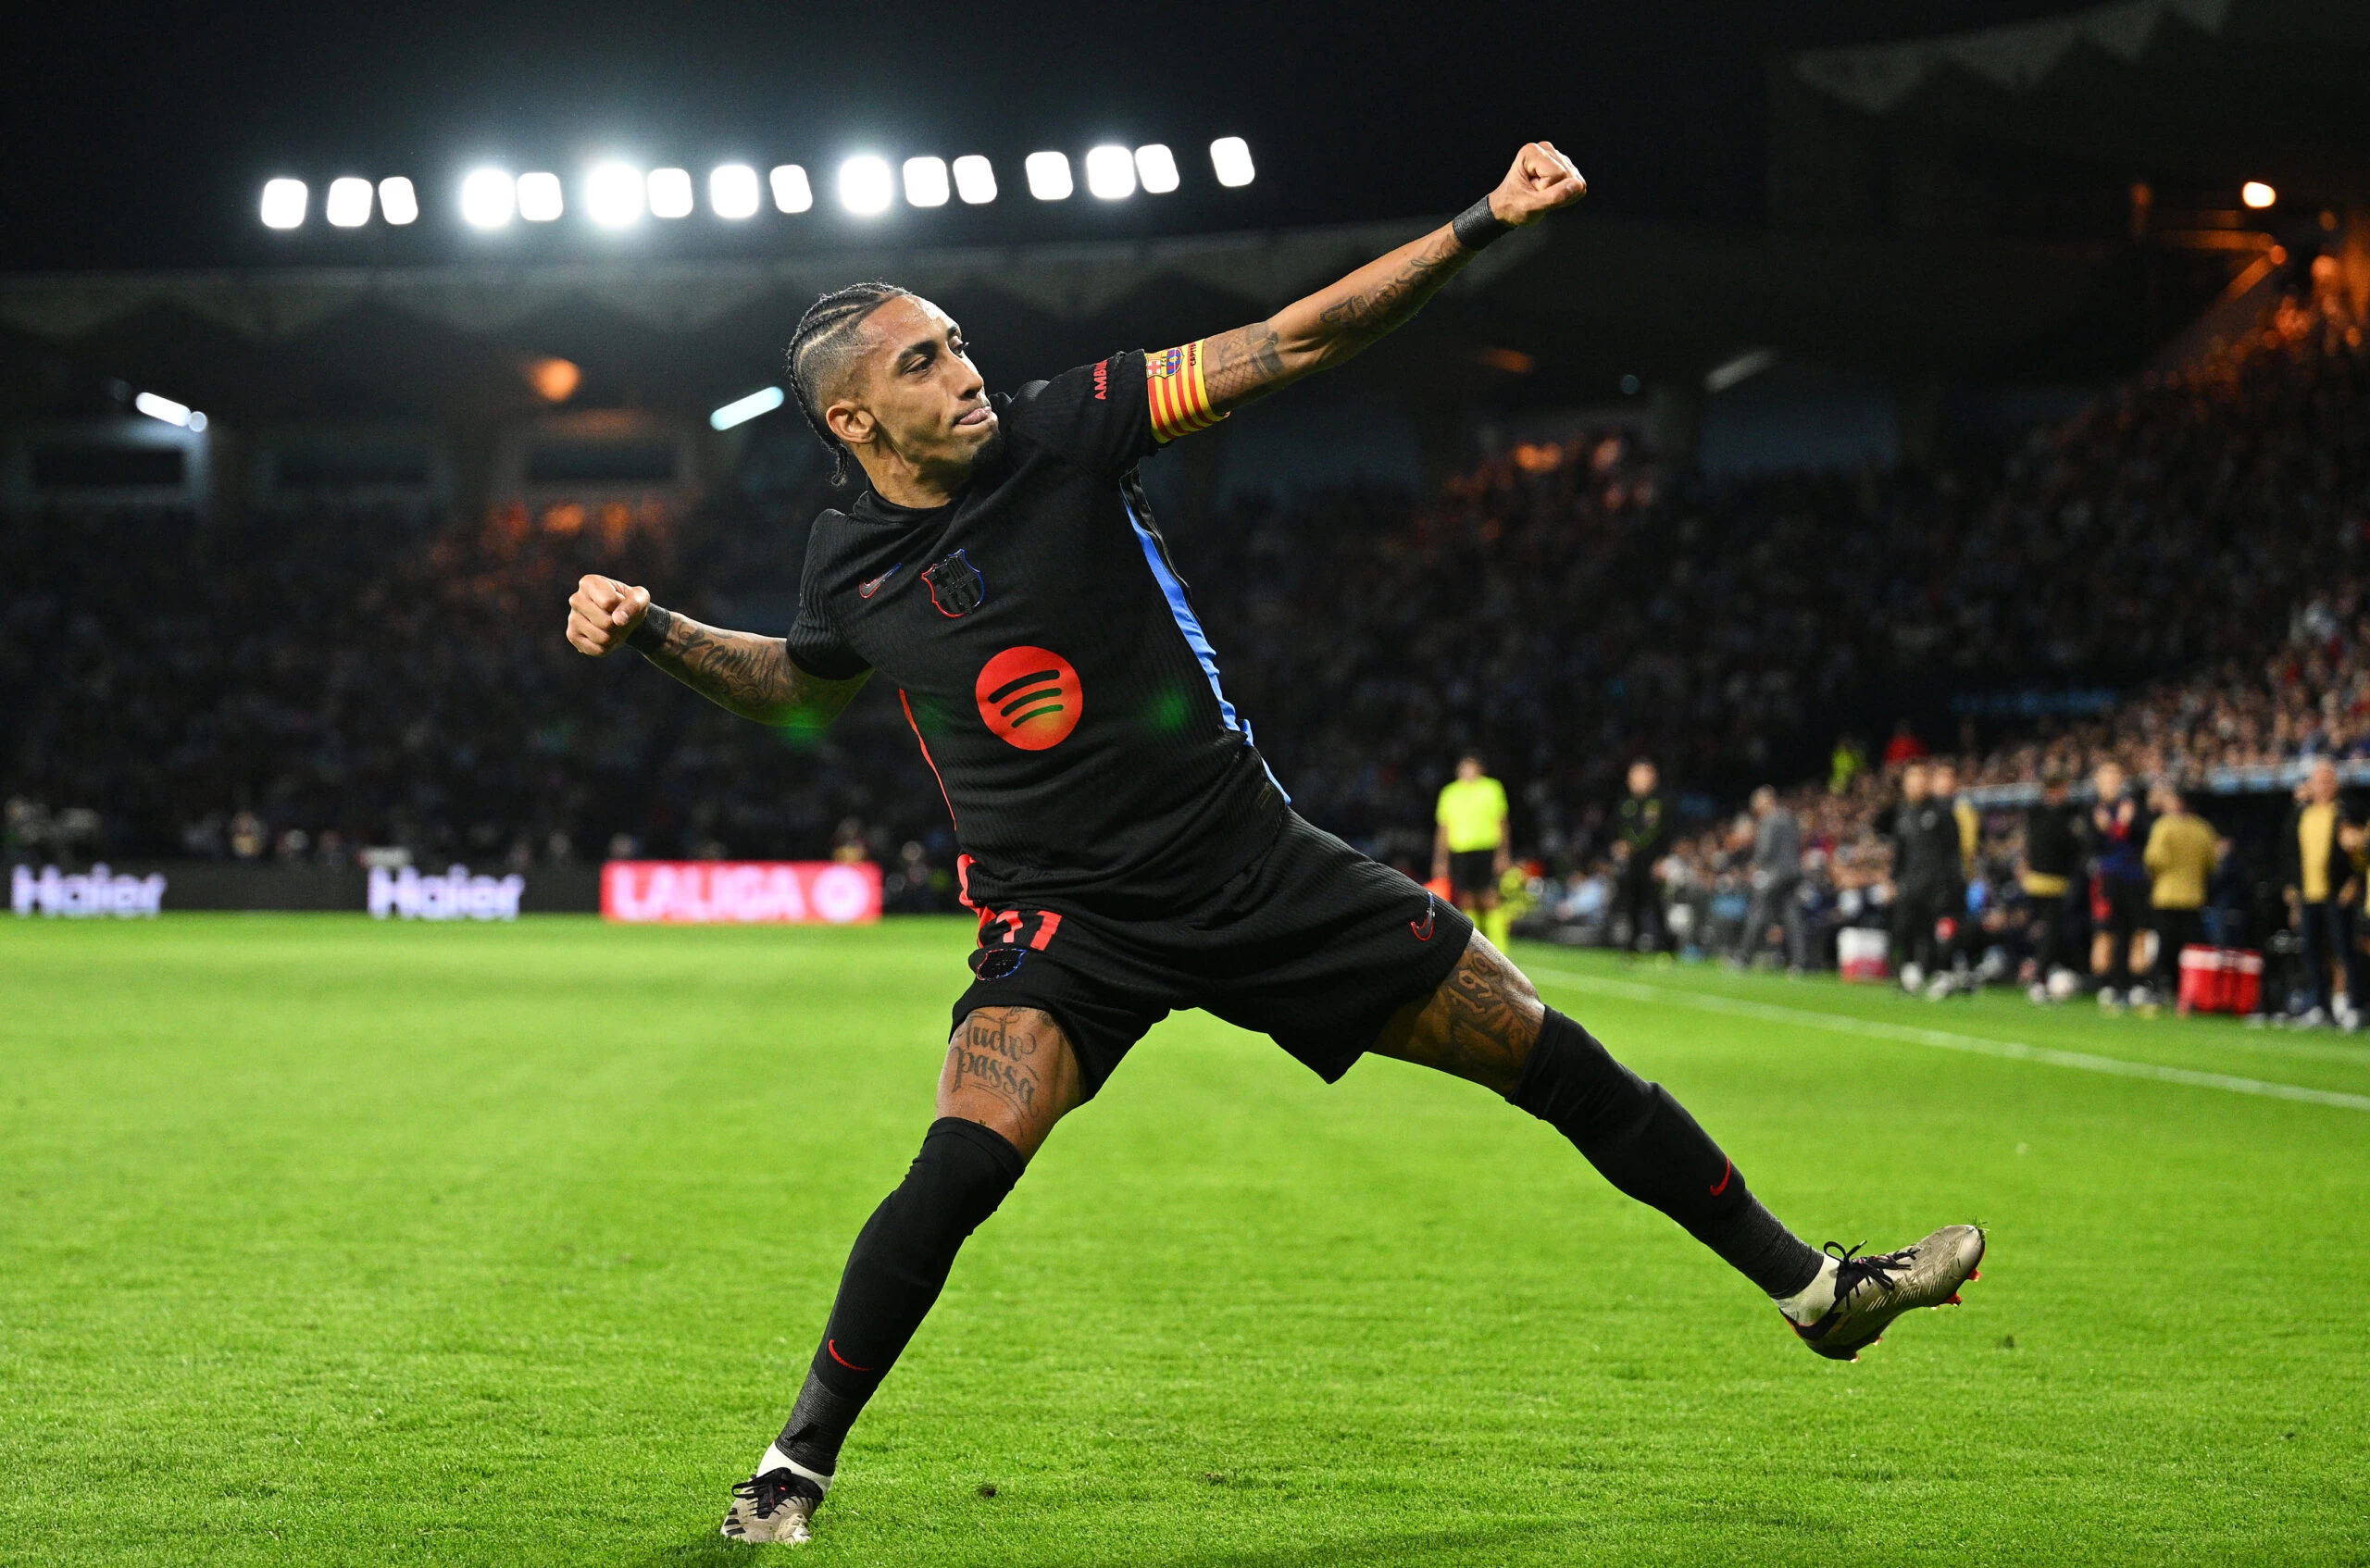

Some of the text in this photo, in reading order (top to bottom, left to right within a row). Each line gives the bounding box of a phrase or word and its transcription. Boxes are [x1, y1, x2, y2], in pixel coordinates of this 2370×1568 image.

[11, 863, 167, 918] Haier
[368, 864, 525, 920] Haier
[612, 865, 805, 920] LALIGA
